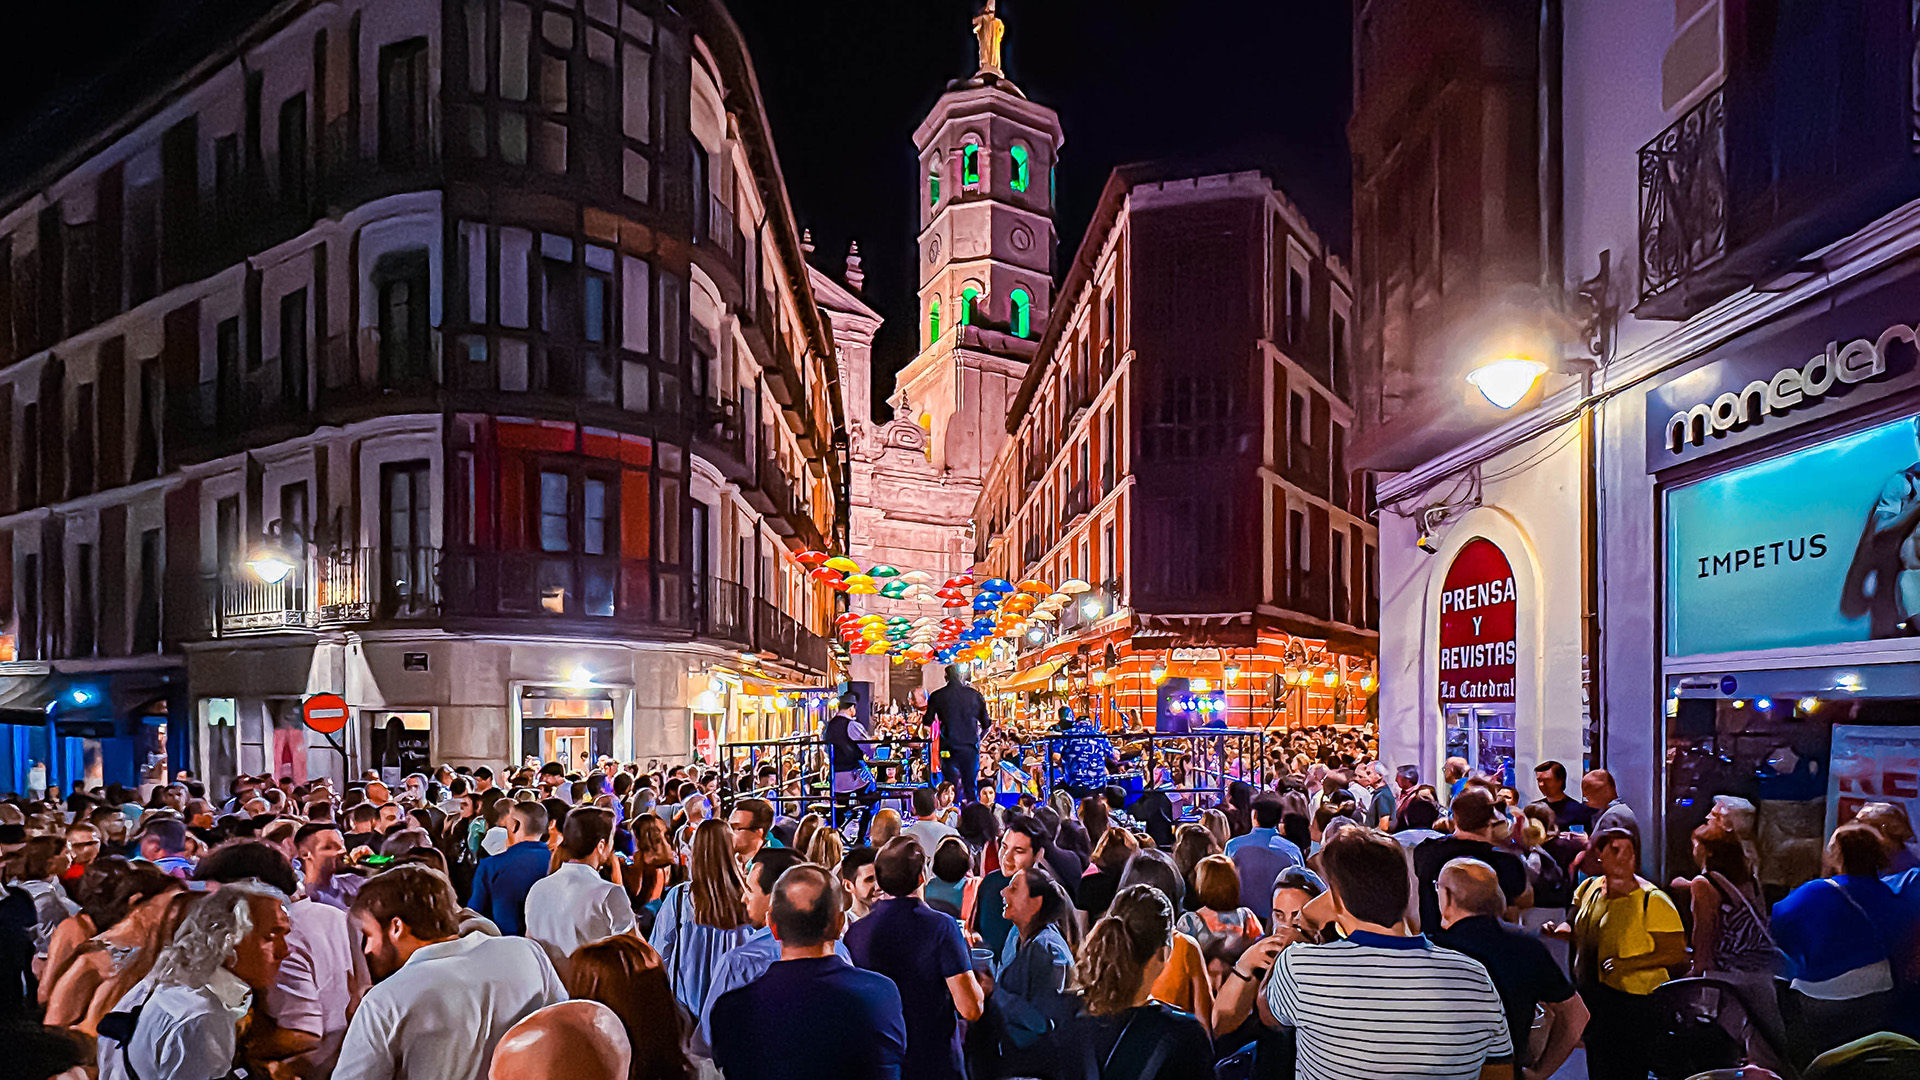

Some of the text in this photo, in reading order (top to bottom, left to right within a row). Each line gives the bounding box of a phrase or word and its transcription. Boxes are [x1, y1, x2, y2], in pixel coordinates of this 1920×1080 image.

[1665, 324, 1920, 450] moneder
[1698, 533, 1827, 578] IMPETUS
[1442, 577, 1516, 614] PRENSA
[1472, 615, 1483, 636] Y
[1441, 640, 1516, 670] REVISTAS
[1440, 677, 1515, 699] La Catedral
